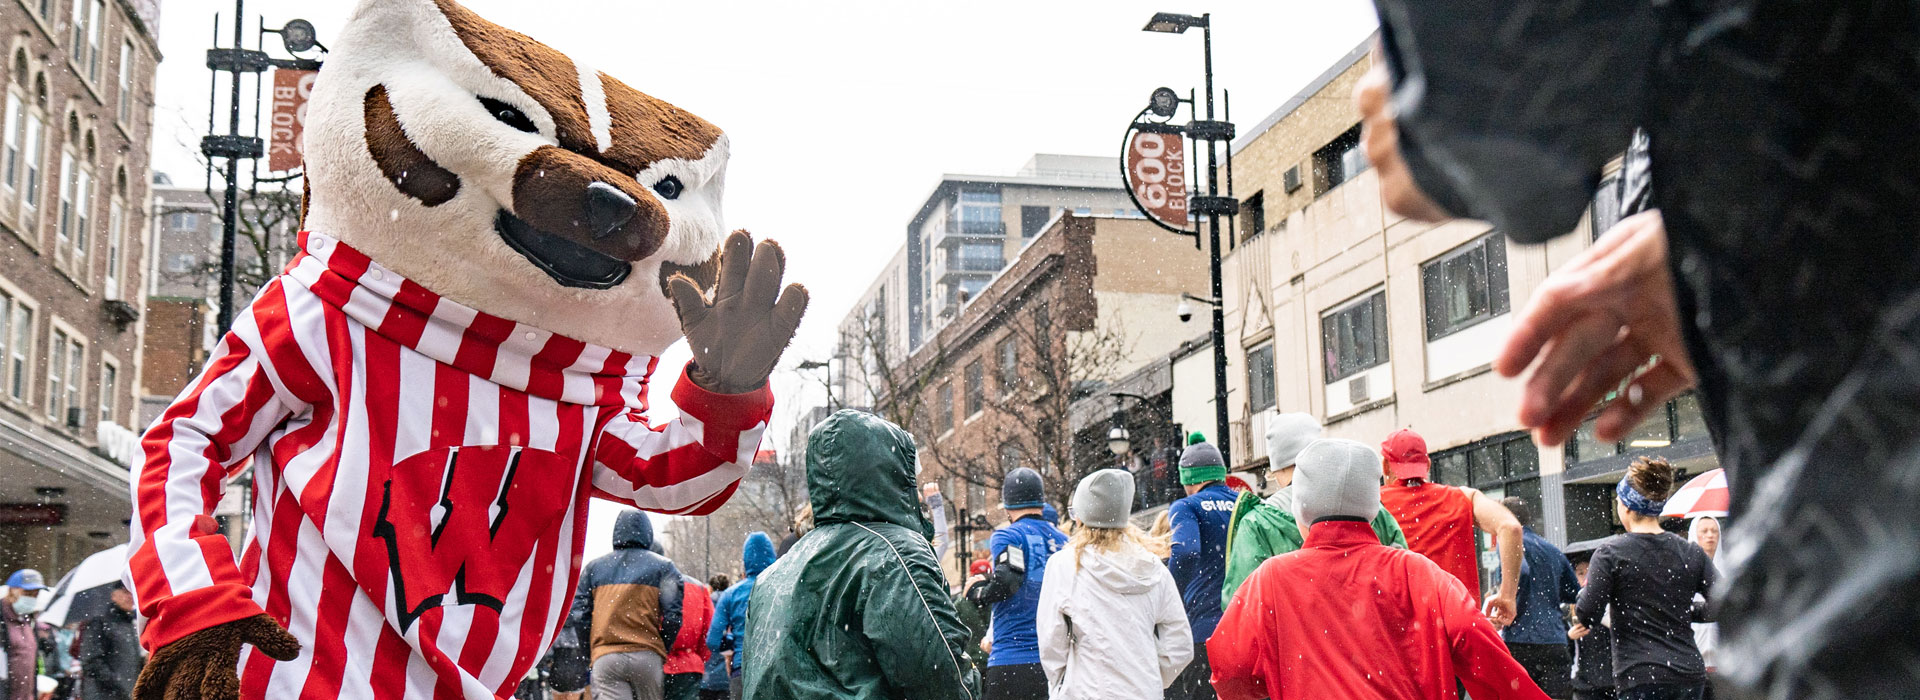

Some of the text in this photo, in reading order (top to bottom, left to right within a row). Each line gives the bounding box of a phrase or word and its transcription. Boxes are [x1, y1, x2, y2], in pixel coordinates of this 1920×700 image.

[273, 87, 296, 154] BLOCK
[1135, 132, 1167, 209] 600
[1167, 149, 1186, 210] BLOCK
[373, 446, 569, 637] W
